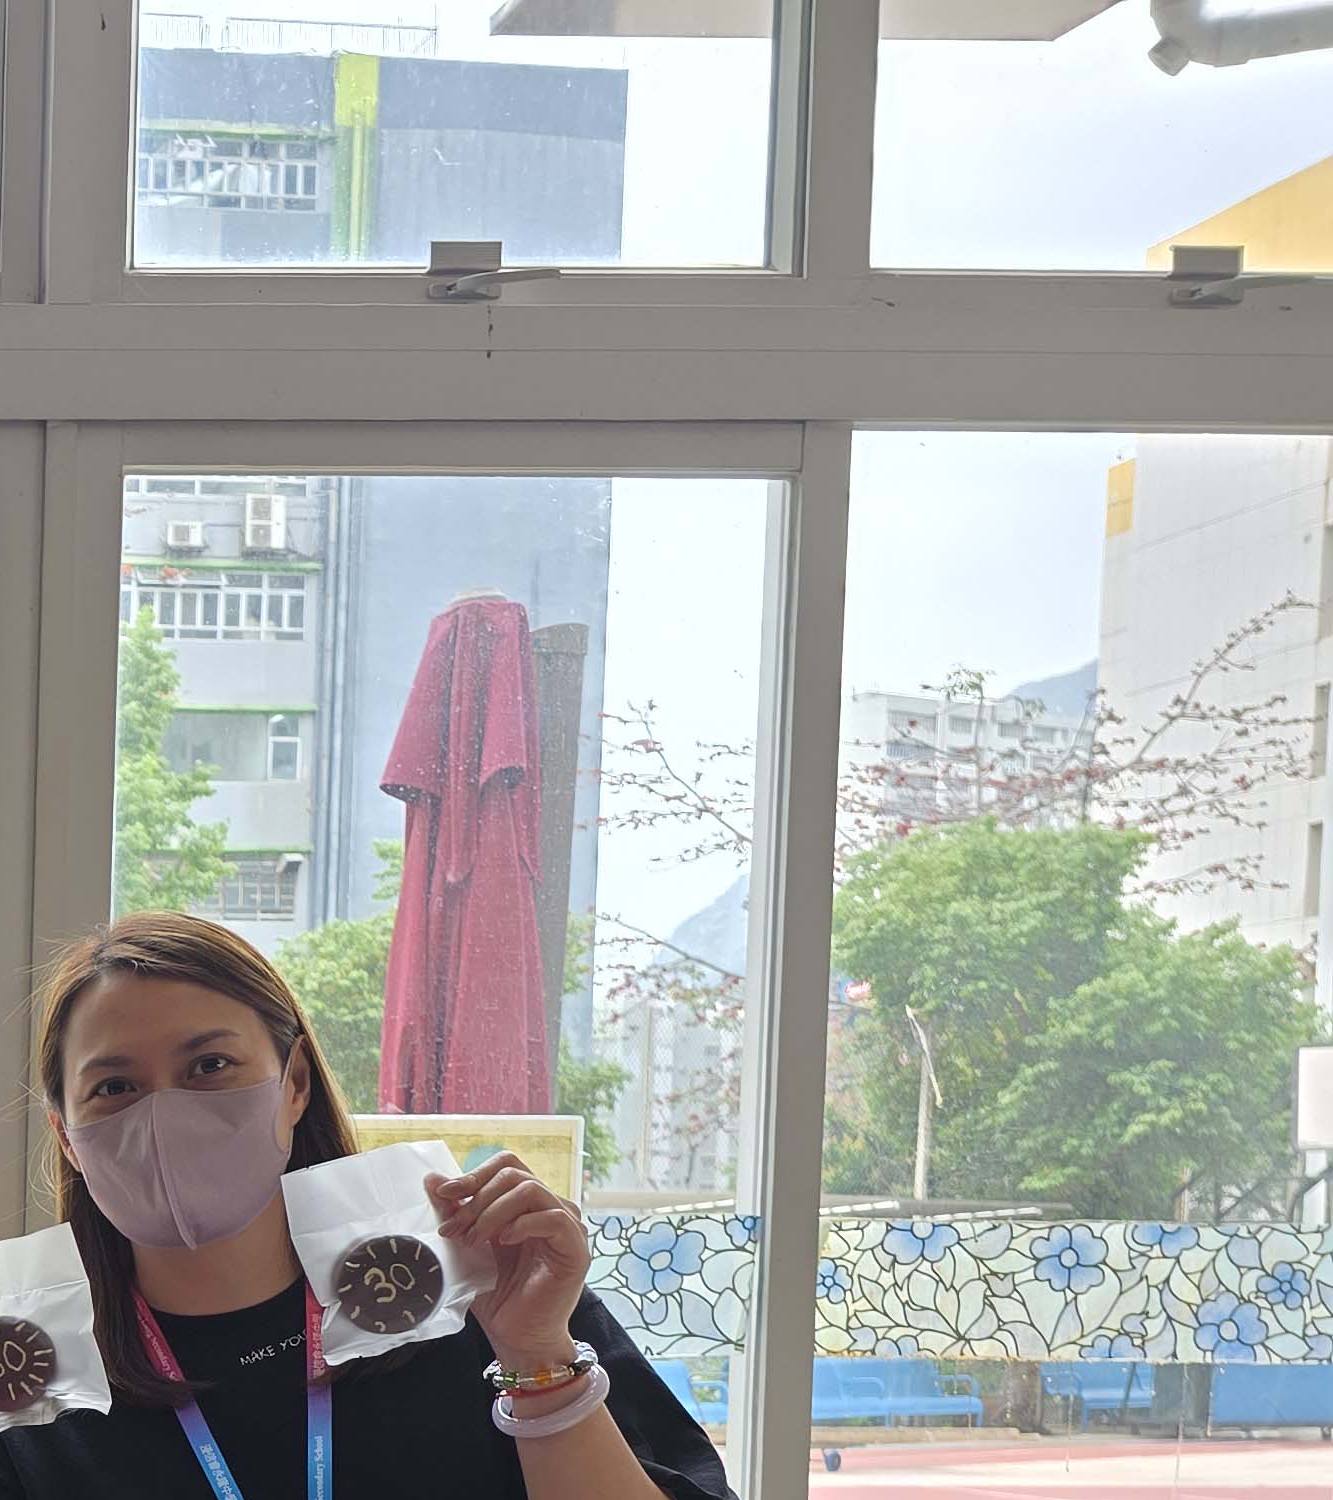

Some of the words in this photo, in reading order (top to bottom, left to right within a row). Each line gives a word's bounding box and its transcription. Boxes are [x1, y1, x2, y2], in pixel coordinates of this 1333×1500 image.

[363, 1262, 415, 1303] 30
[239, 1345, 276, 1366] MAKE
[314, 1435, 326, 1462] School
